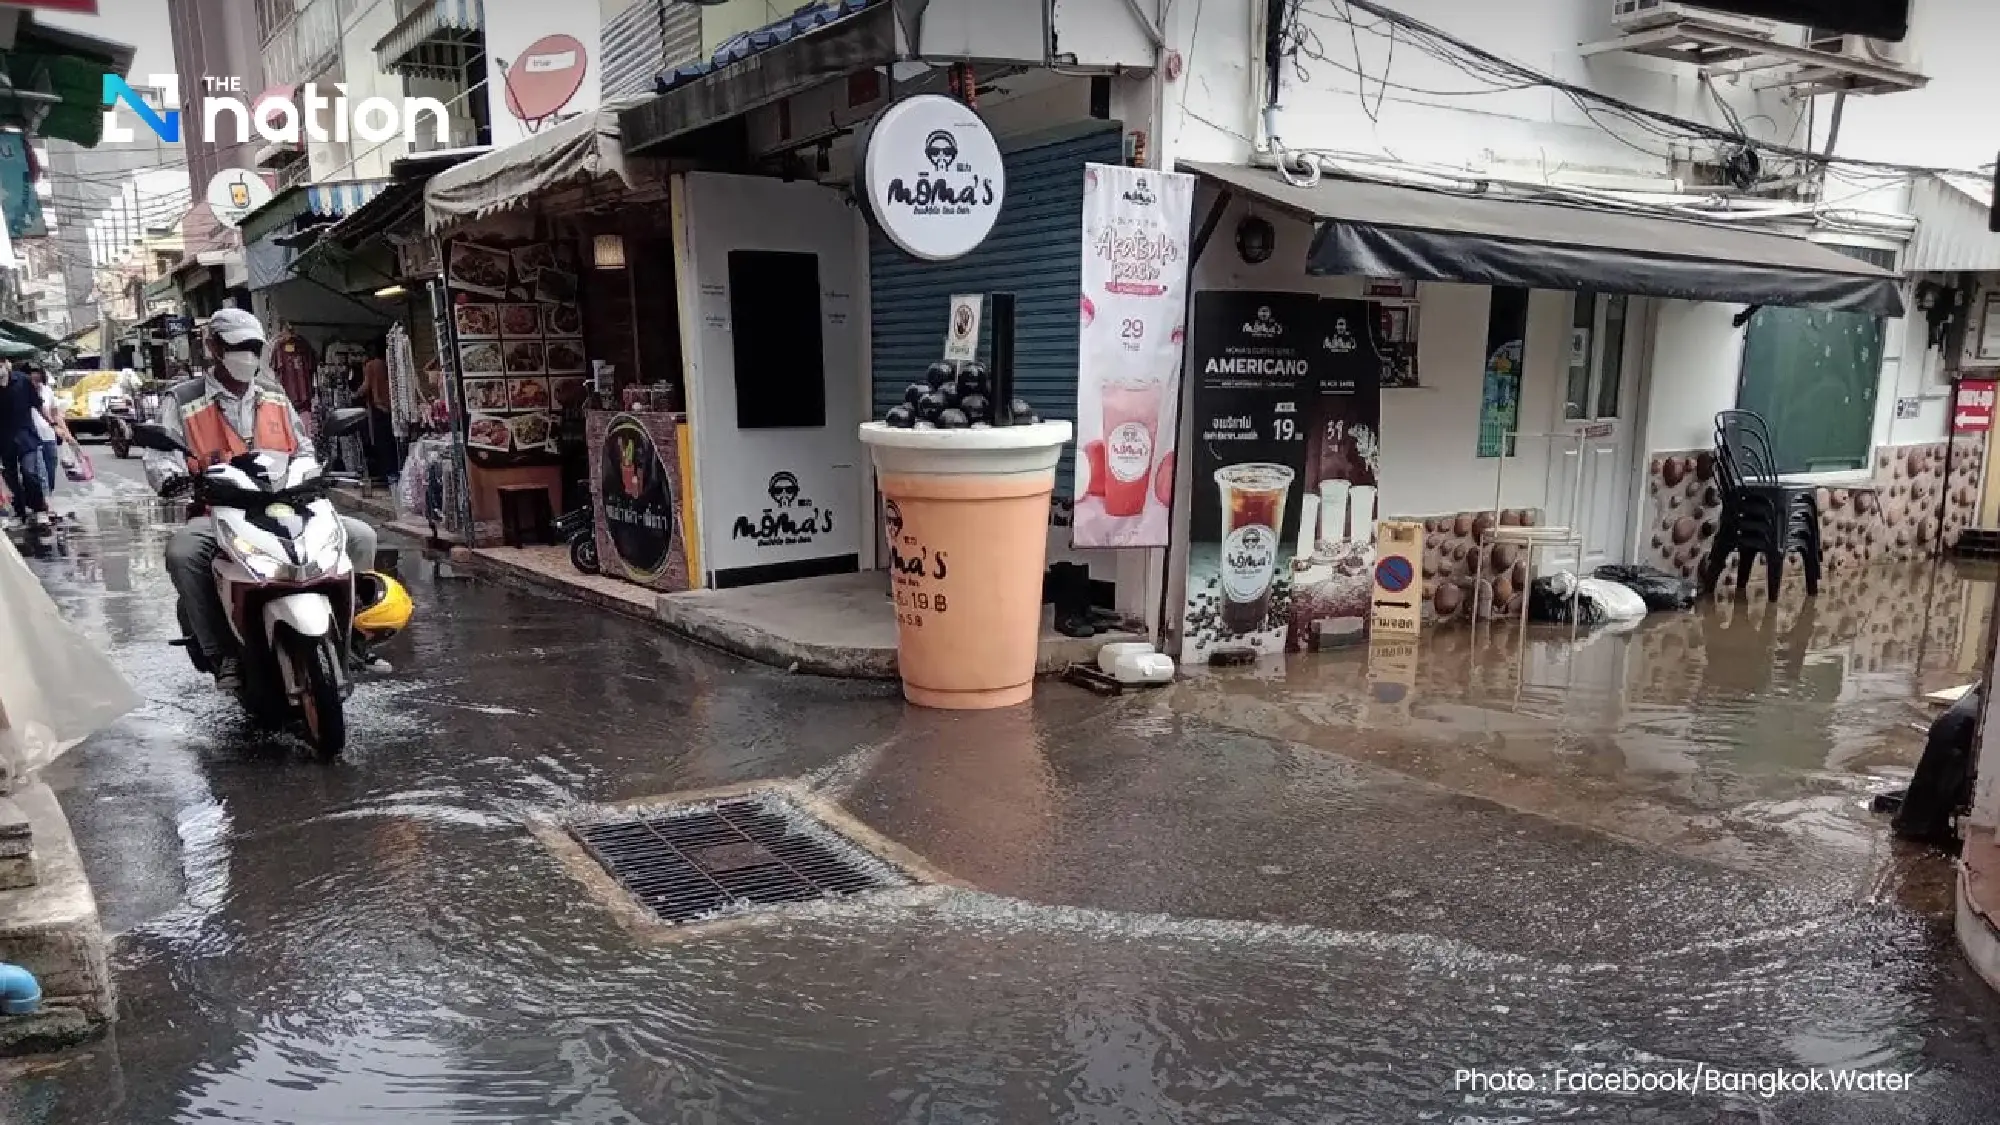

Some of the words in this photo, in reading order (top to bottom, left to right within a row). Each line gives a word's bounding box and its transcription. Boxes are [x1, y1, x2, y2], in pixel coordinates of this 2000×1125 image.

[1121, 318, 1144, 339] 29
[1204, 357, 1309, 376] AMERICANO
[1273, 418, 1295, 440] 19
